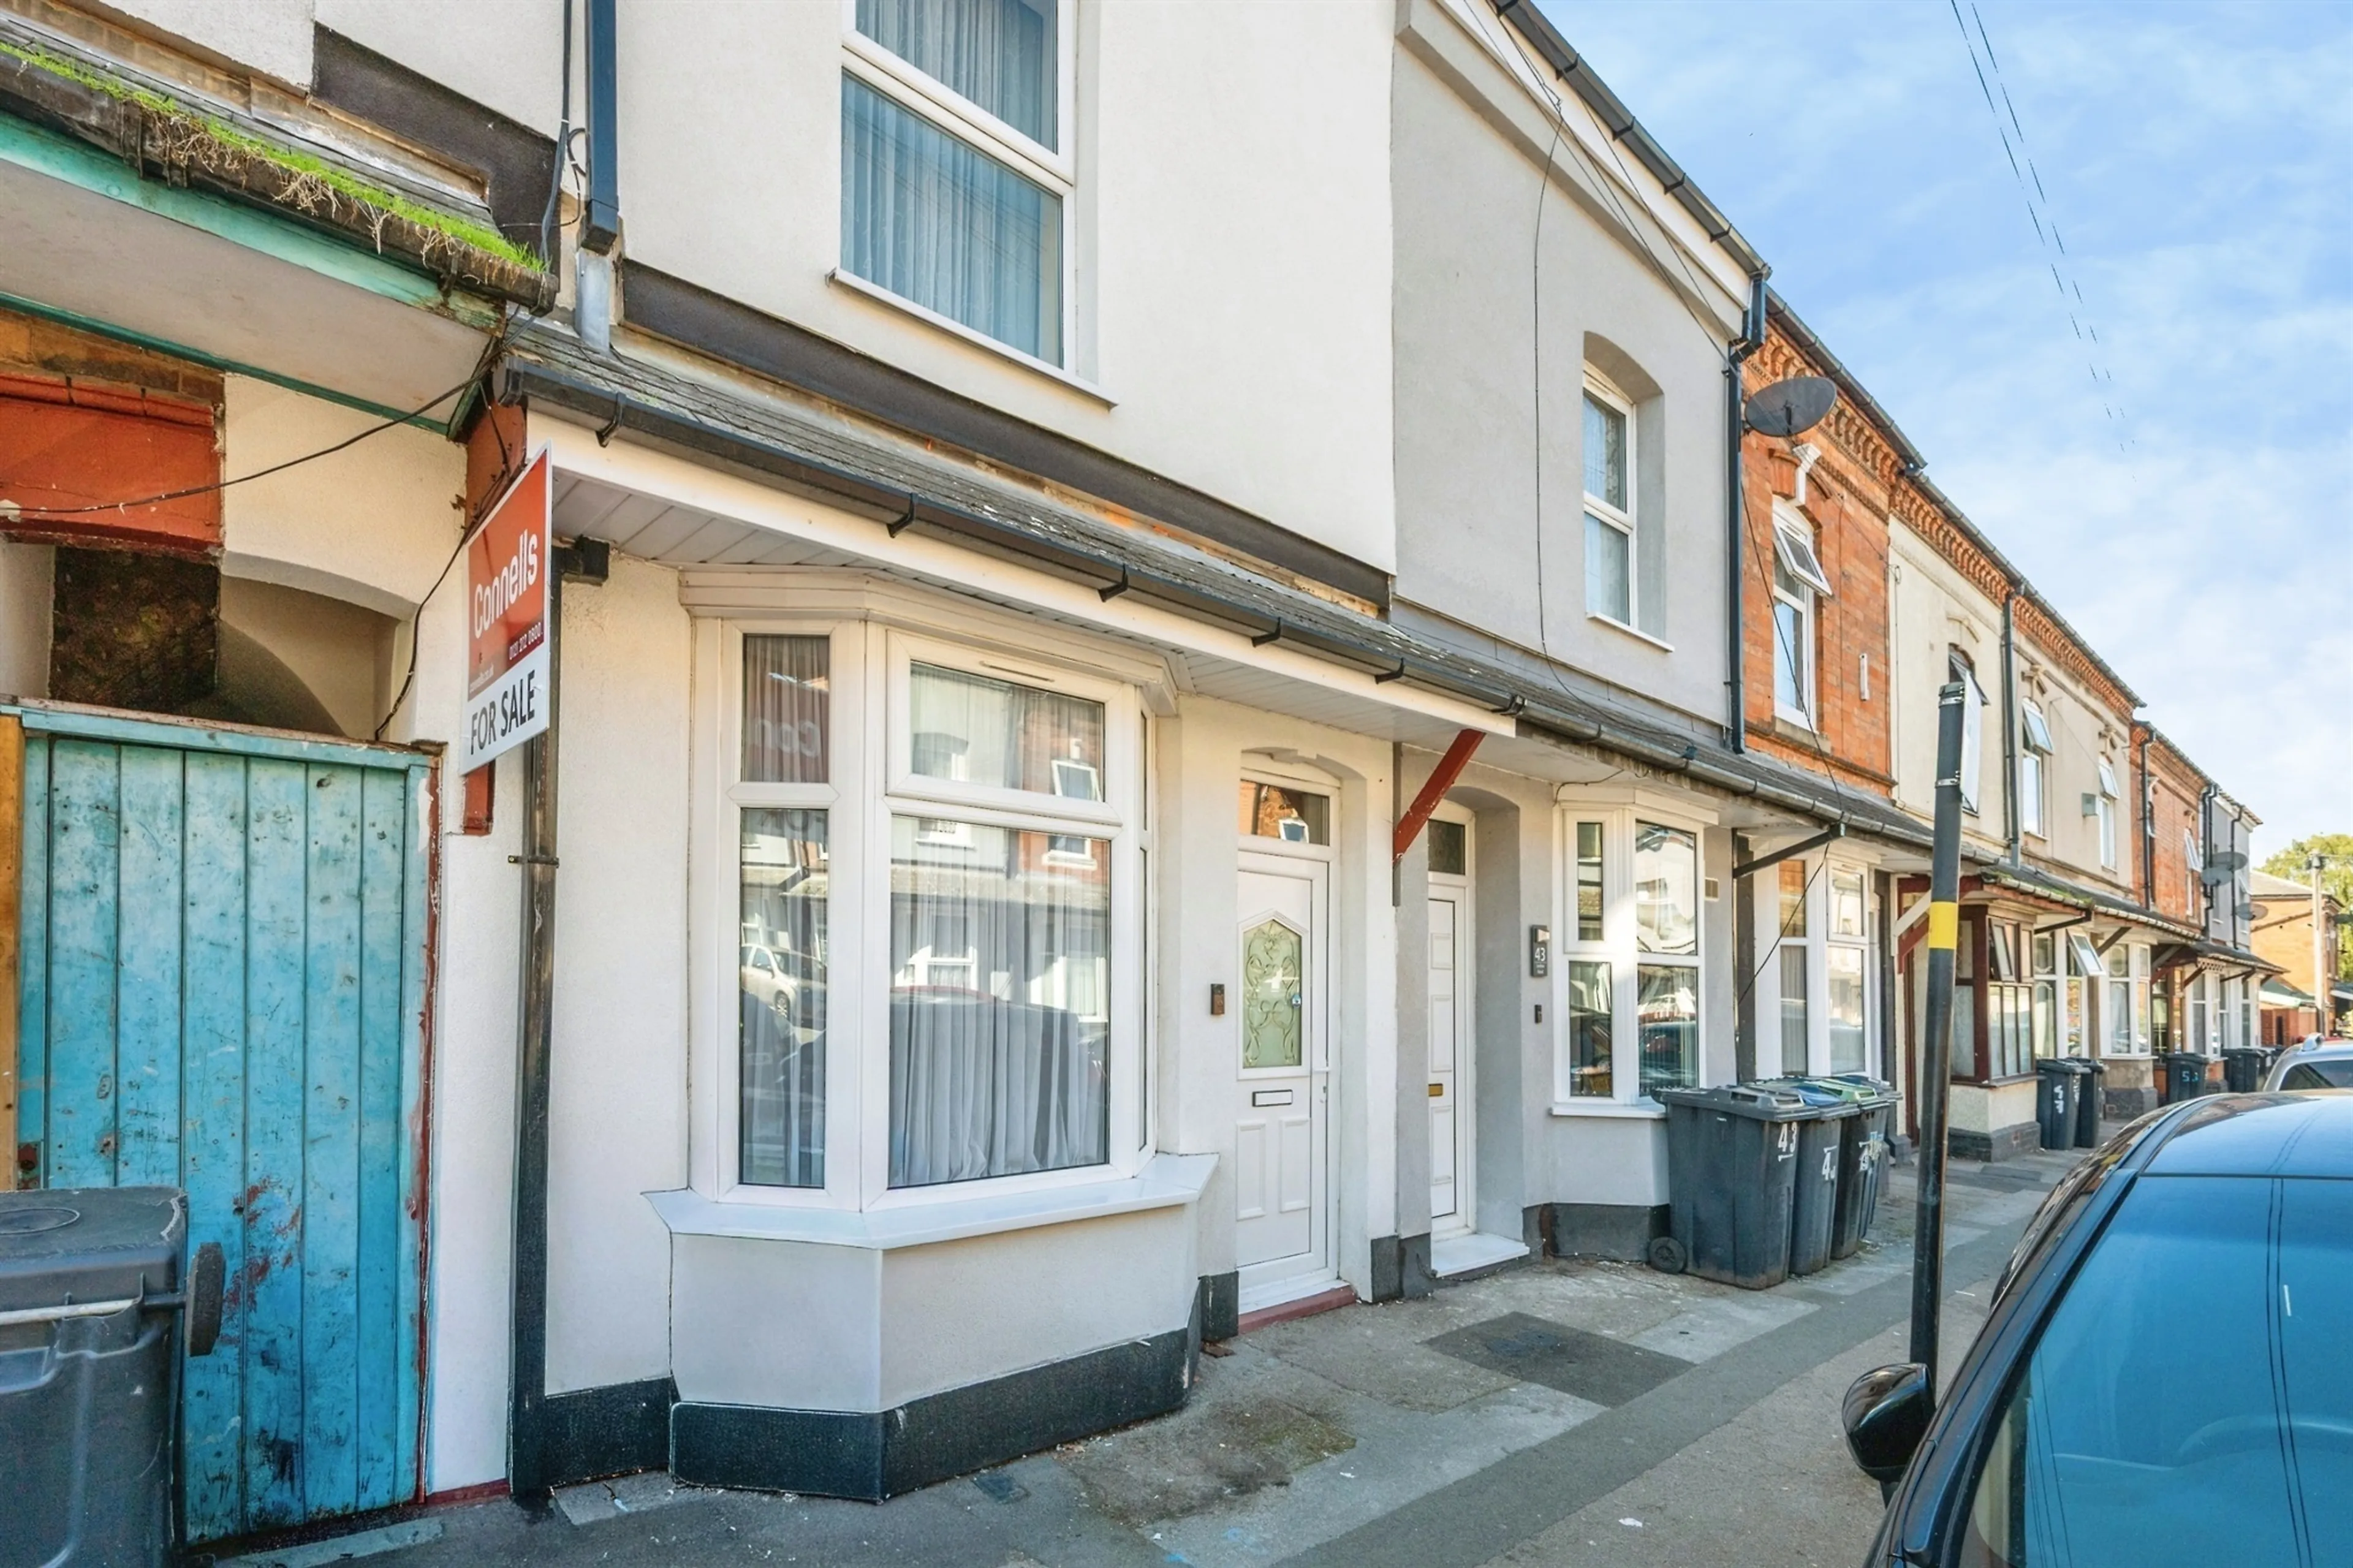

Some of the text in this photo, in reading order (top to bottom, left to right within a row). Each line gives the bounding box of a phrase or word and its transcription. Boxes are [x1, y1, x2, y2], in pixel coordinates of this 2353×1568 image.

[474, 528, 538, 639] Connells
[471, 669, 536, 756] FOR SALE
[1535, 947, 1545, 961] 43
[1778, 1121, 1797, 1153] 43
